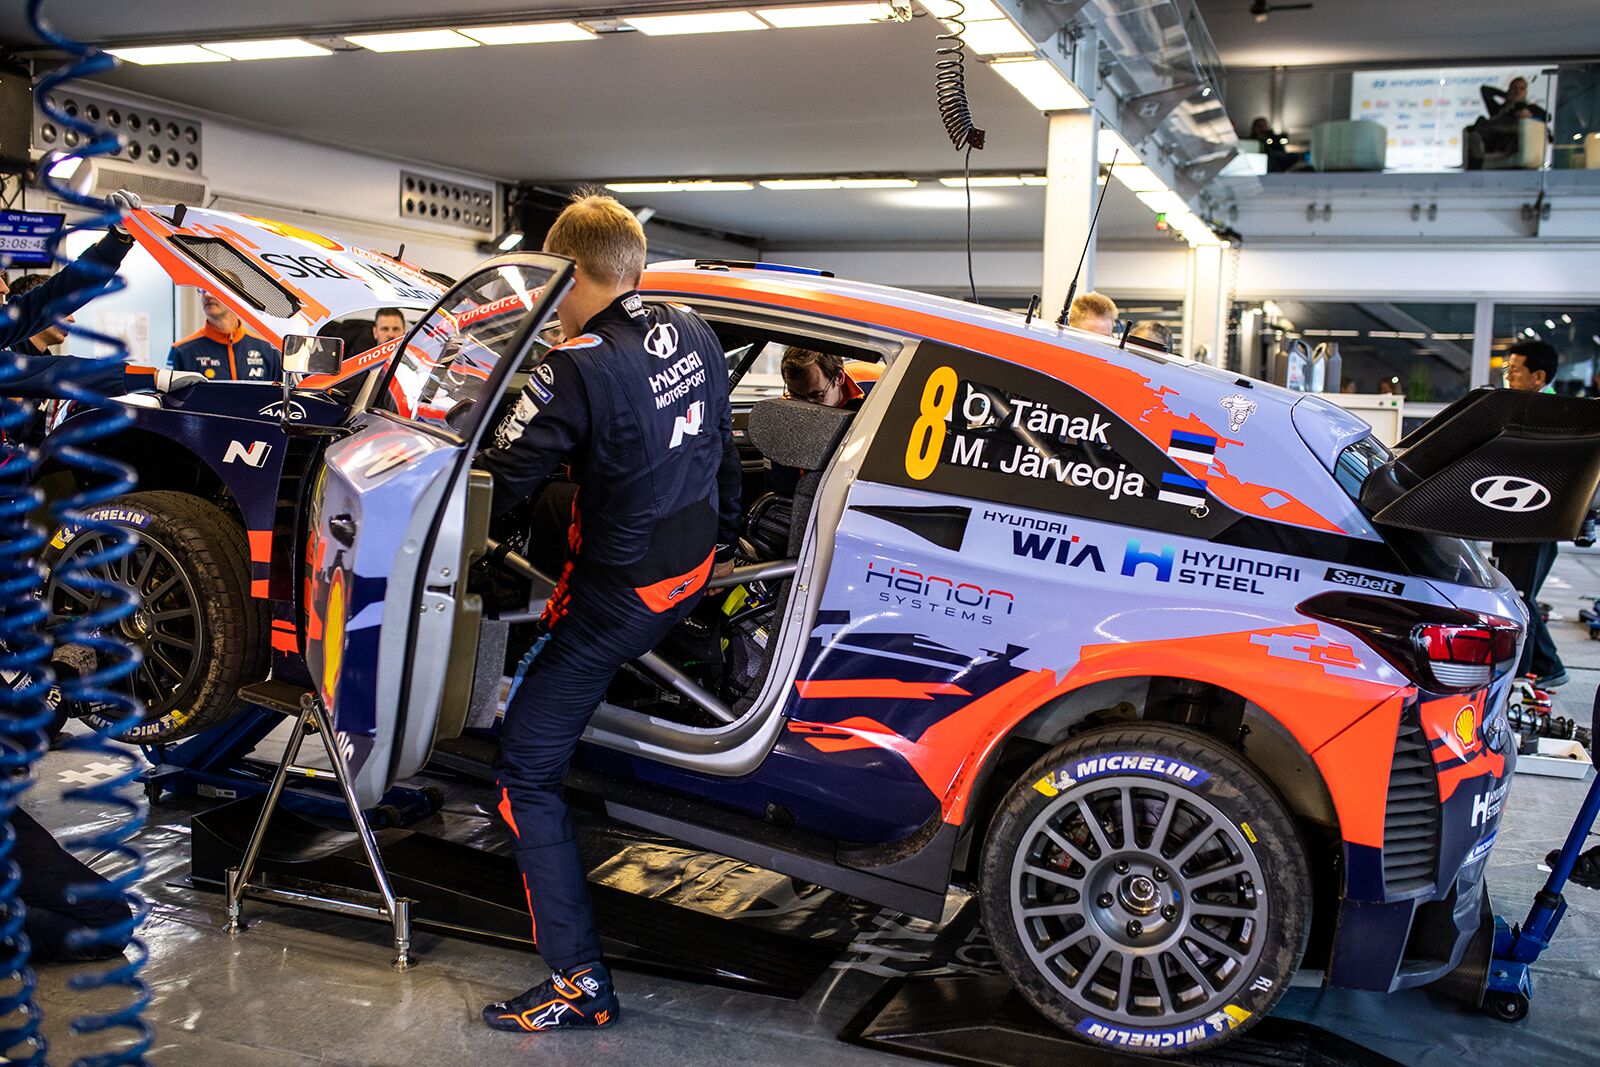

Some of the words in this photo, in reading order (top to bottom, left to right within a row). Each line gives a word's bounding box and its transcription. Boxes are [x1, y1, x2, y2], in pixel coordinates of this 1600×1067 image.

[904, 365, 959, 481] 8
[1009, 399, 1112, 444] Tänak
[950, 434, 989, 469] M.
[999, 444, 1145, 501] Järveoja
[982, 510, 1068, 536] HYUNDAI
[1012, 530, 1106, 573] WIA
[1182, 548, 1300, 583] HYUNDAI
[1178, 569, 1265, 595] STEEL
[1331, 569, 1398, 594] Sabelt
[879, 592, 993, 625] SYSTEMS
[1076, 755, 1198, 782] MICHELIN
[1087, 1023, 1207, 1048] MICHELIN
